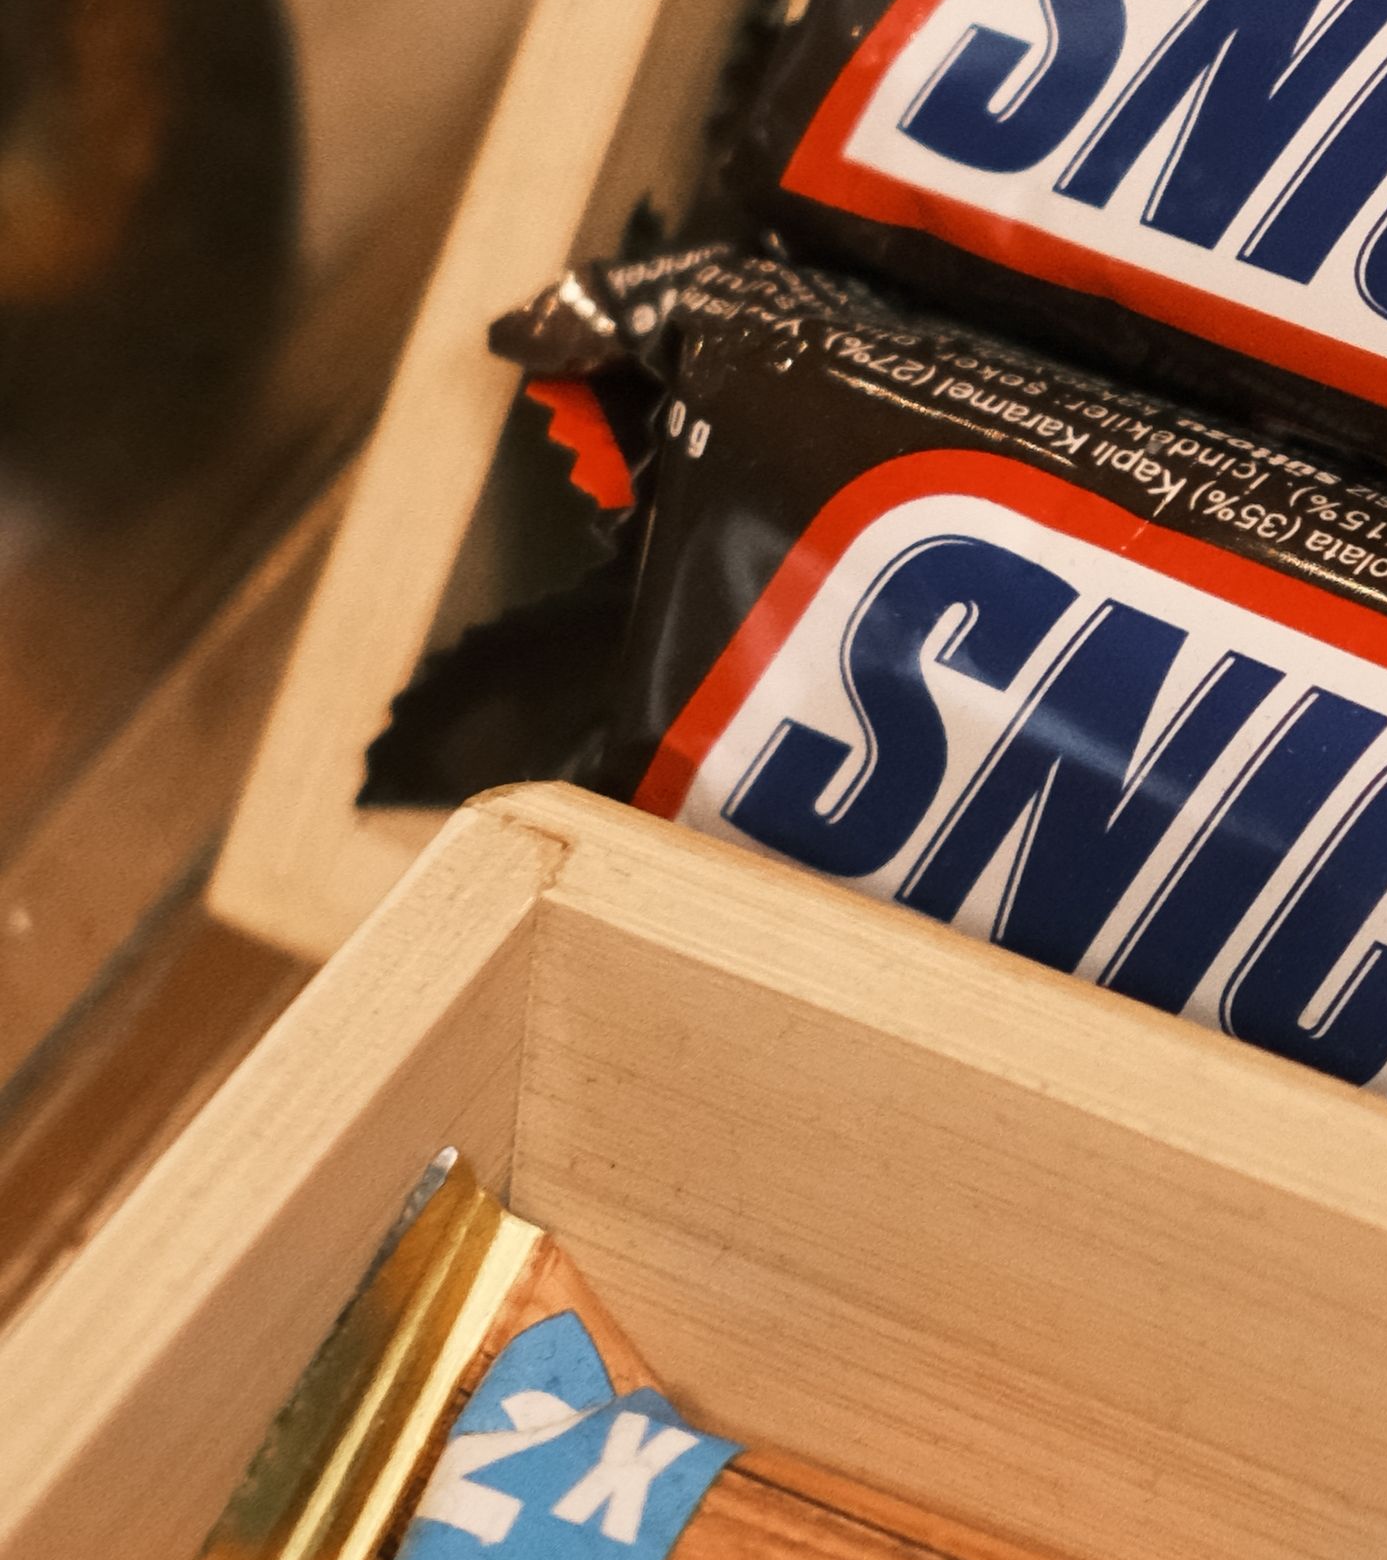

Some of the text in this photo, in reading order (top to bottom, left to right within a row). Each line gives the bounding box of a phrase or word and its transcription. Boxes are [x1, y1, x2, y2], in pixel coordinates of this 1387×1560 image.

[685, 415, 713, 458] g
[933, 378, 1086, 454] Karamel
[1057, 383, 1267, 494] İçindekiler:
[1092, 441, 1186, 504] Kaplı
[1189, 481, 1302, 543] (35%)
